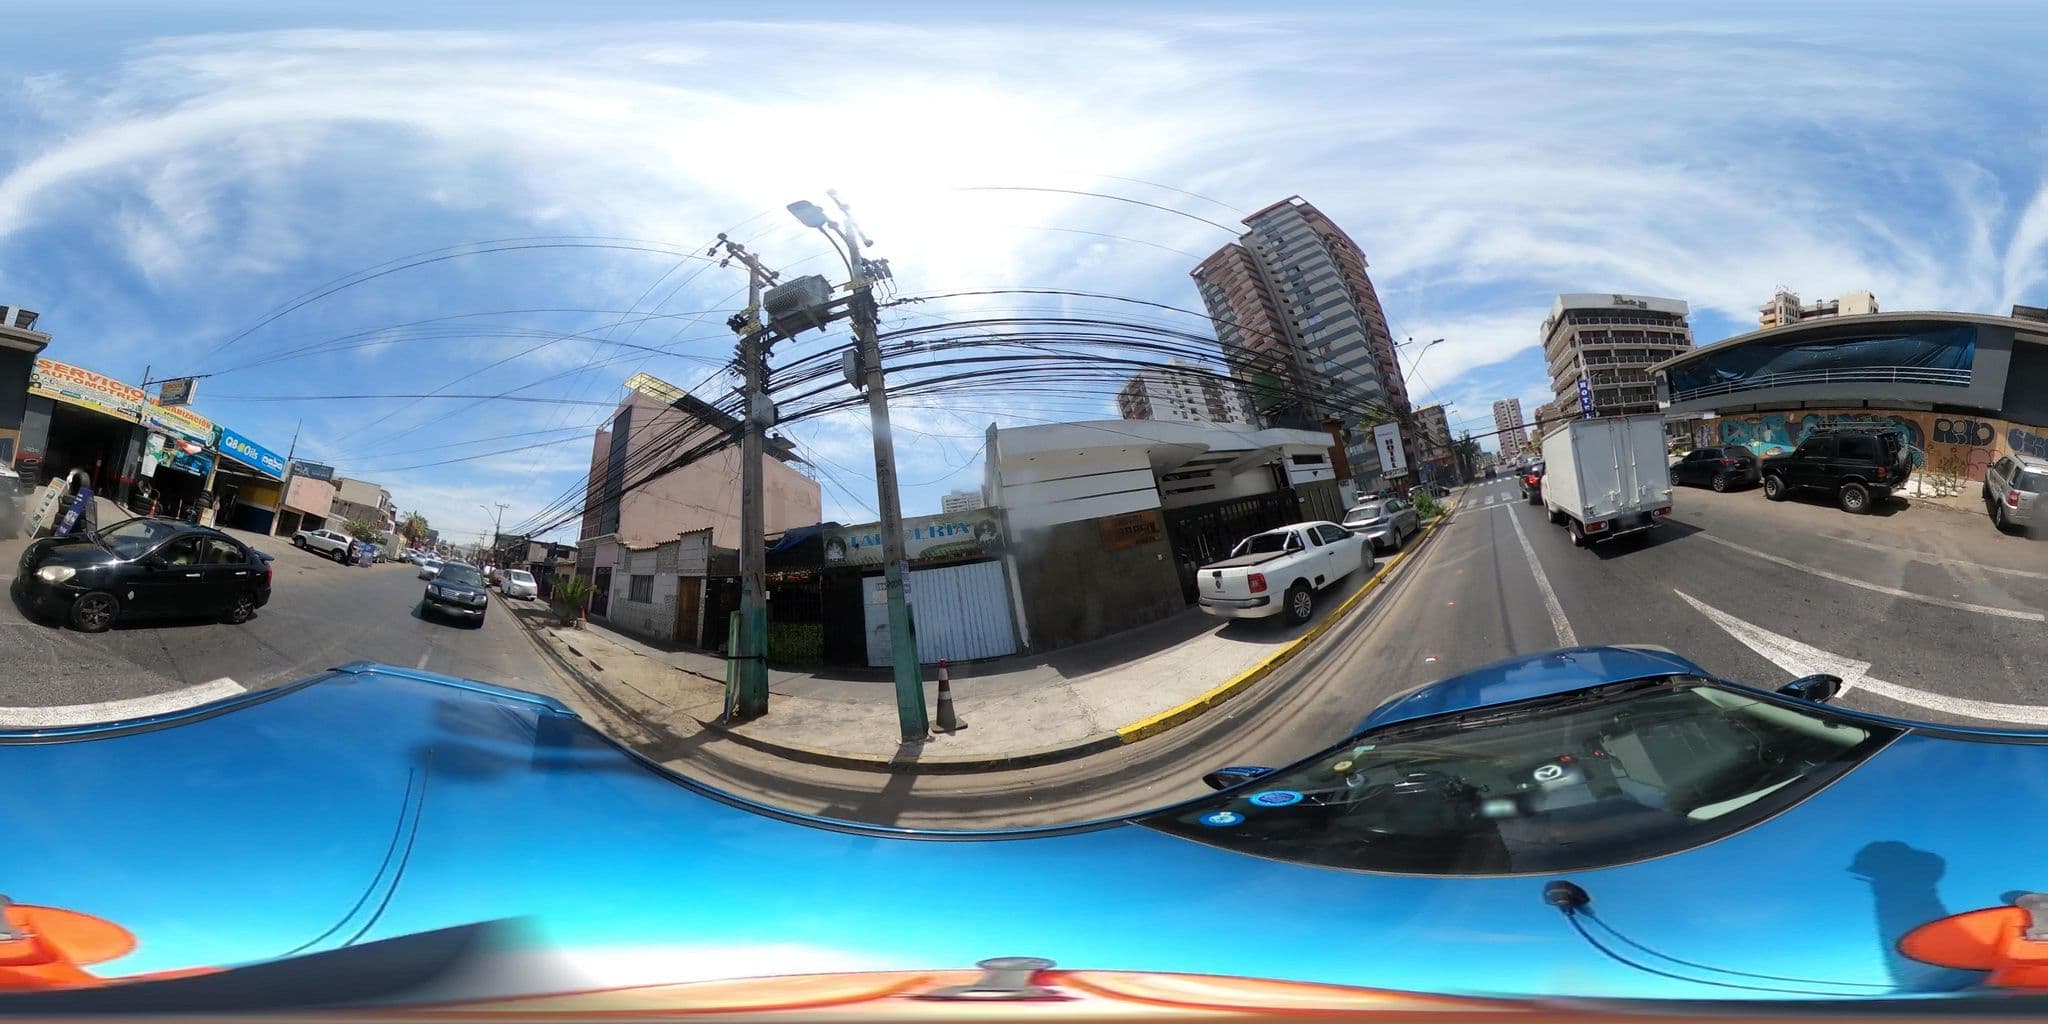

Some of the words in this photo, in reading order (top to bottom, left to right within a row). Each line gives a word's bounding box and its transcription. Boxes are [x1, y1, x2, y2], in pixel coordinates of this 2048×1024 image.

[37, 359, 145, 399] SERVICIO
[40, 369, 139, 405] AUTOMOTRIZ
[1580, 381, 1592, 419] HOTEL
